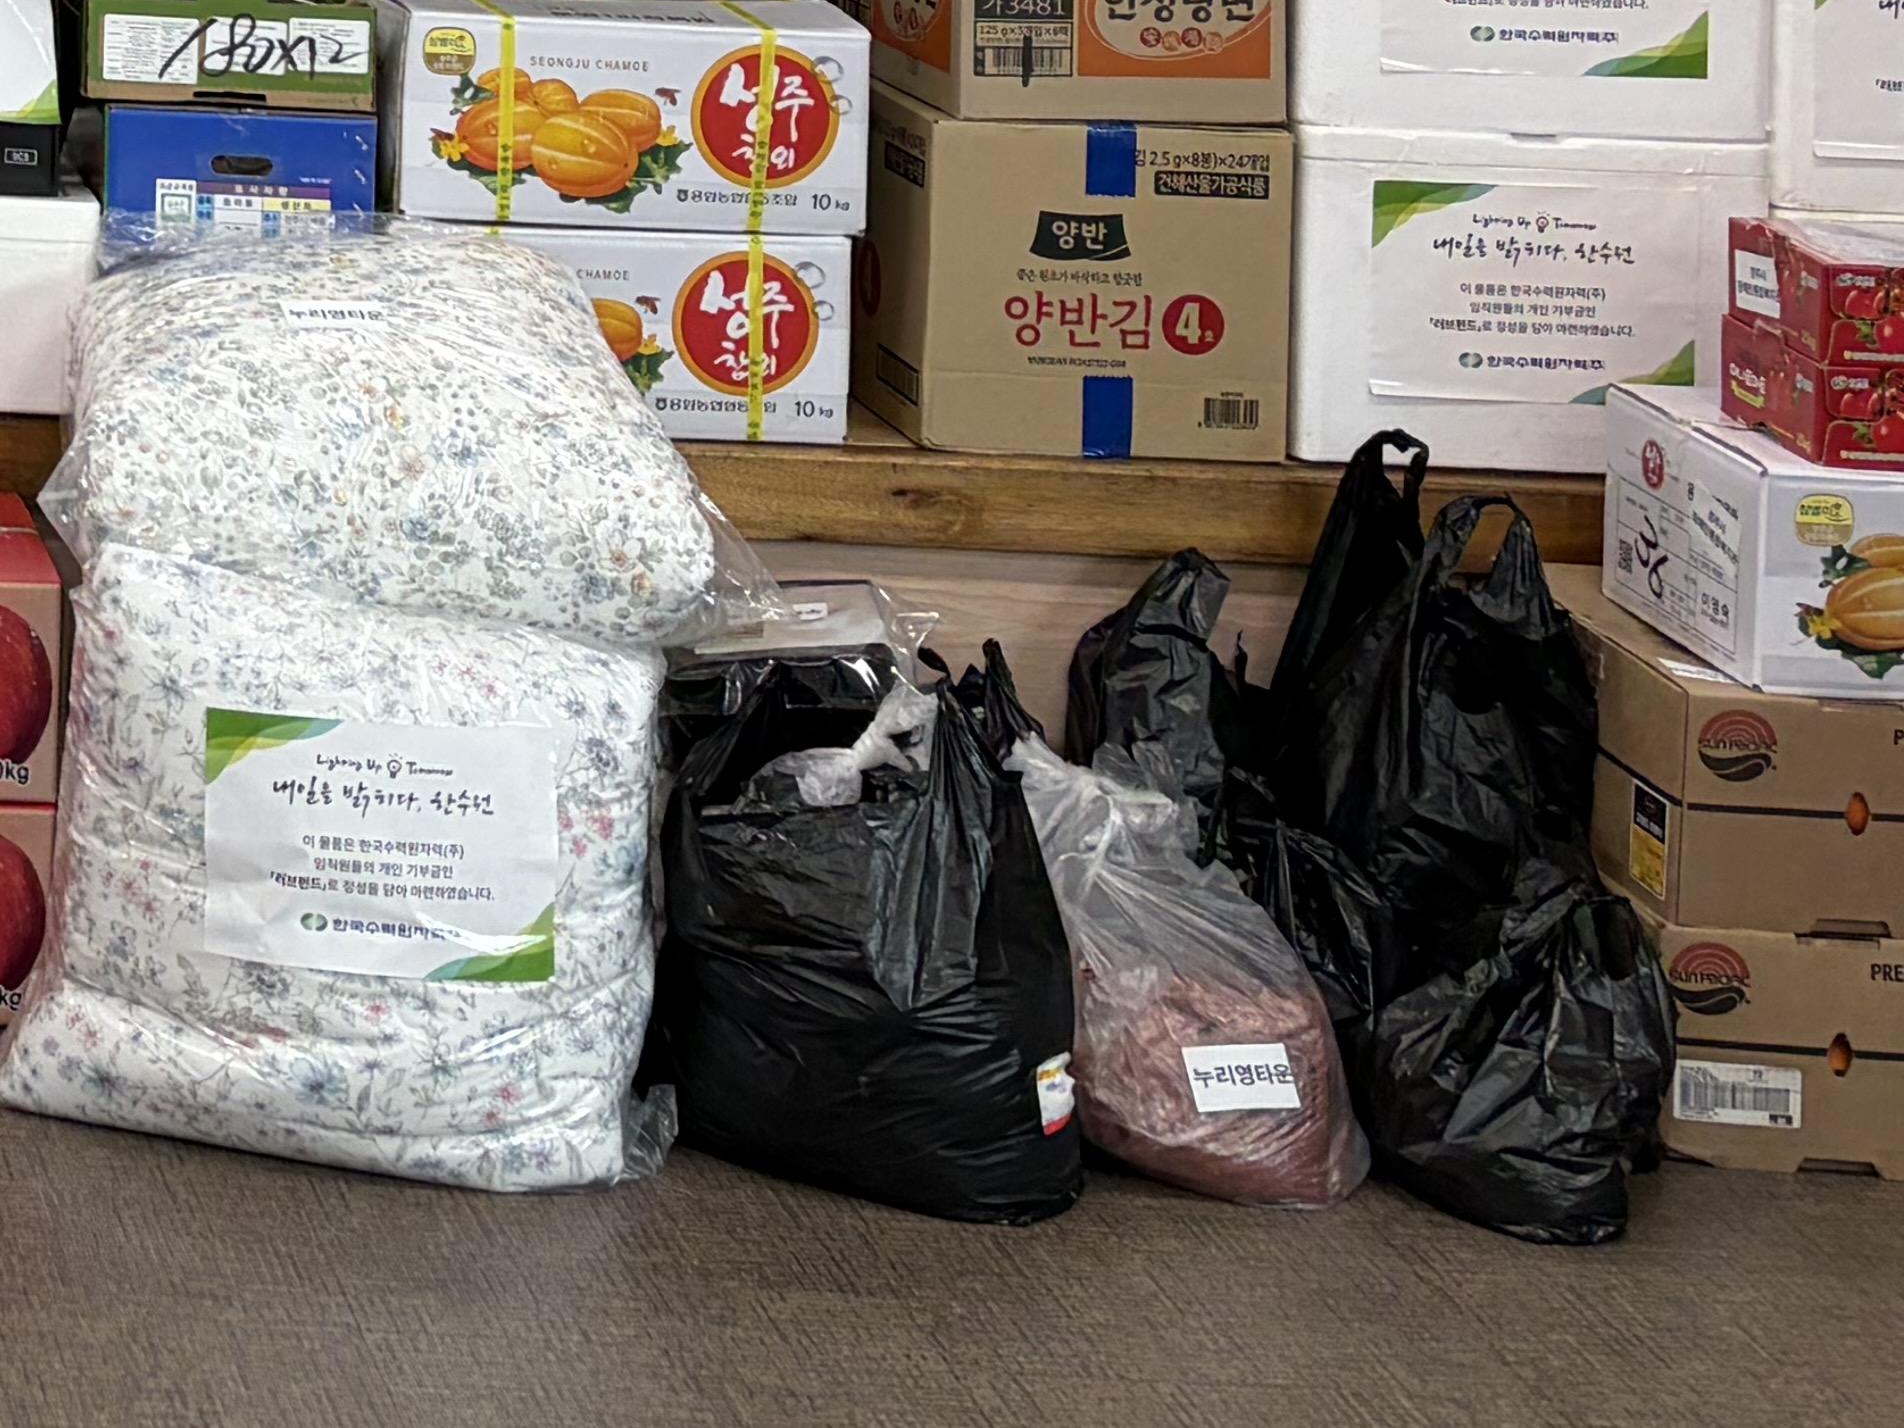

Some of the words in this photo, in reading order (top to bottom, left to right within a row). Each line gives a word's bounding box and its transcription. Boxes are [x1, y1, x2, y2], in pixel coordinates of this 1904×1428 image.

[530, 55, 591, 71] SEONGJU
[596, 58, 650, 74] CHAMOE
[1051, 219, 1108, 251] 양반
[576, 268, 631, 282] CHAMOE
[1004, 290, 1153, 351] 양반김
[271, 775, 333, 805] 내일을
[430, 791, 496, 819] 한수원
[1192, 1063, 1294, 1089] 누리영타운
